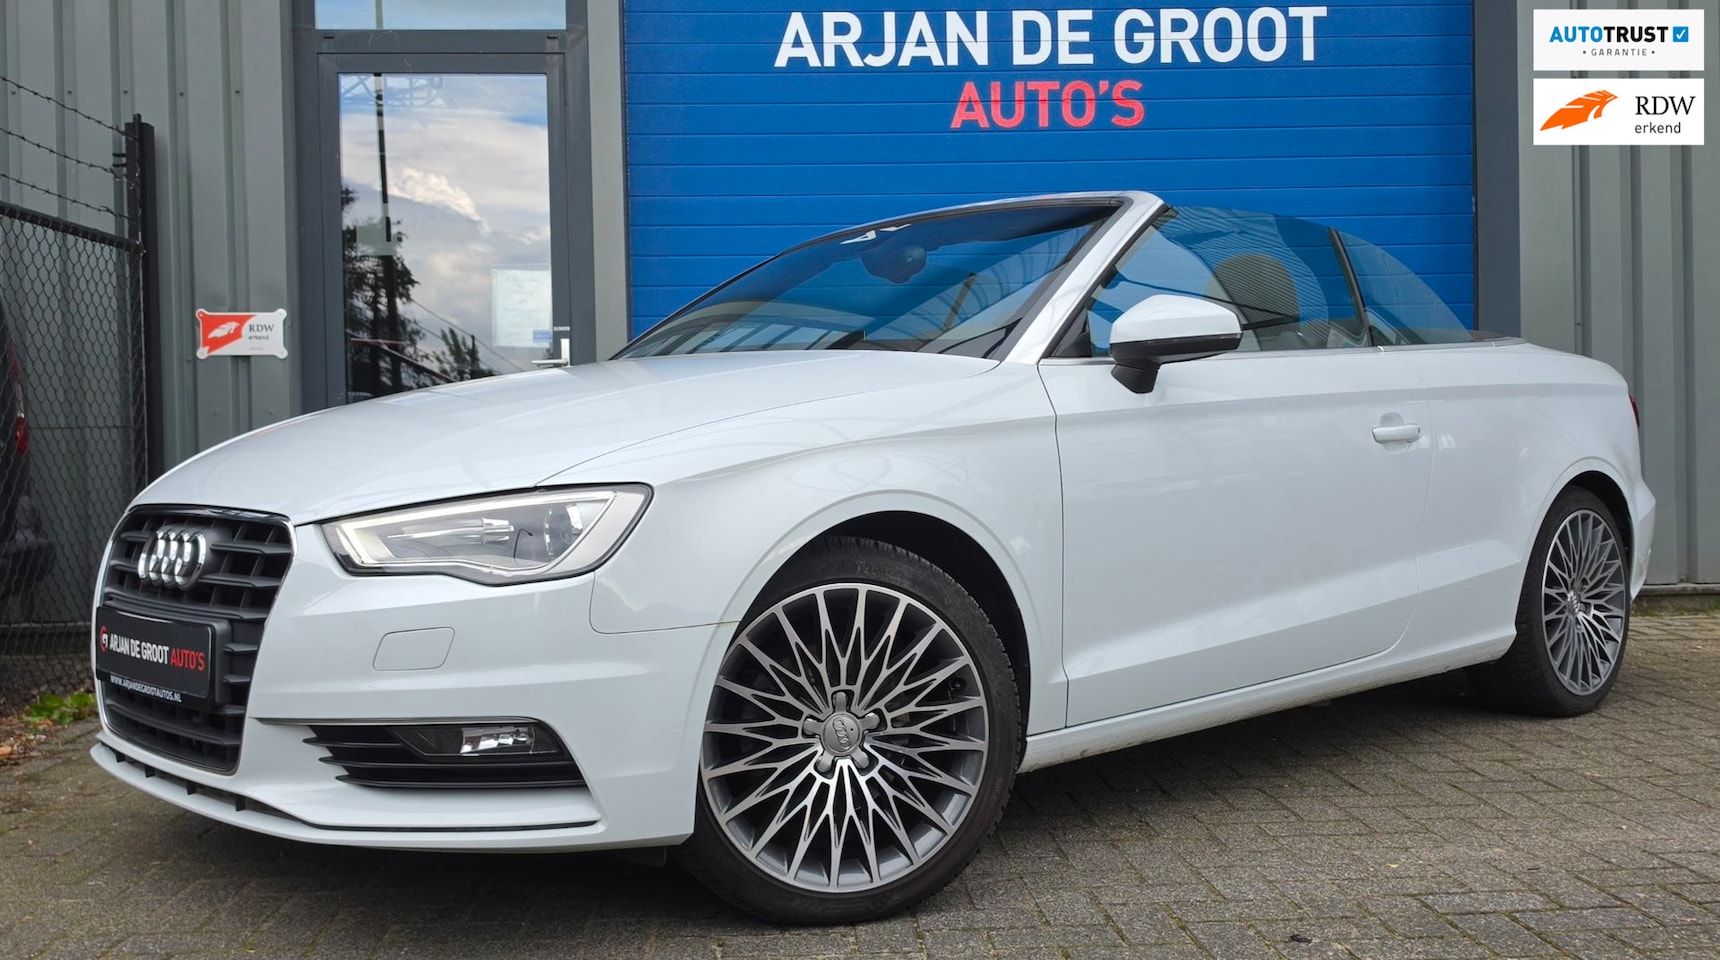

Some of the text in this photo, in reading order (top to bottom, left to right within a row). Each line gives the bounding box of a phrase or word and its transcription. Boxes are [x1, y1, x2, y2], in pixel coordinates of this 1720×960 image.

[773, 6, 1327, 68] ARJAN DE GROOT
[950, 79, 1145, 129] AUTO'S
[248, 323, 275, 333] RDW
[110, 634, 205, 671] ARJAN DE GROOT AUTO'S
